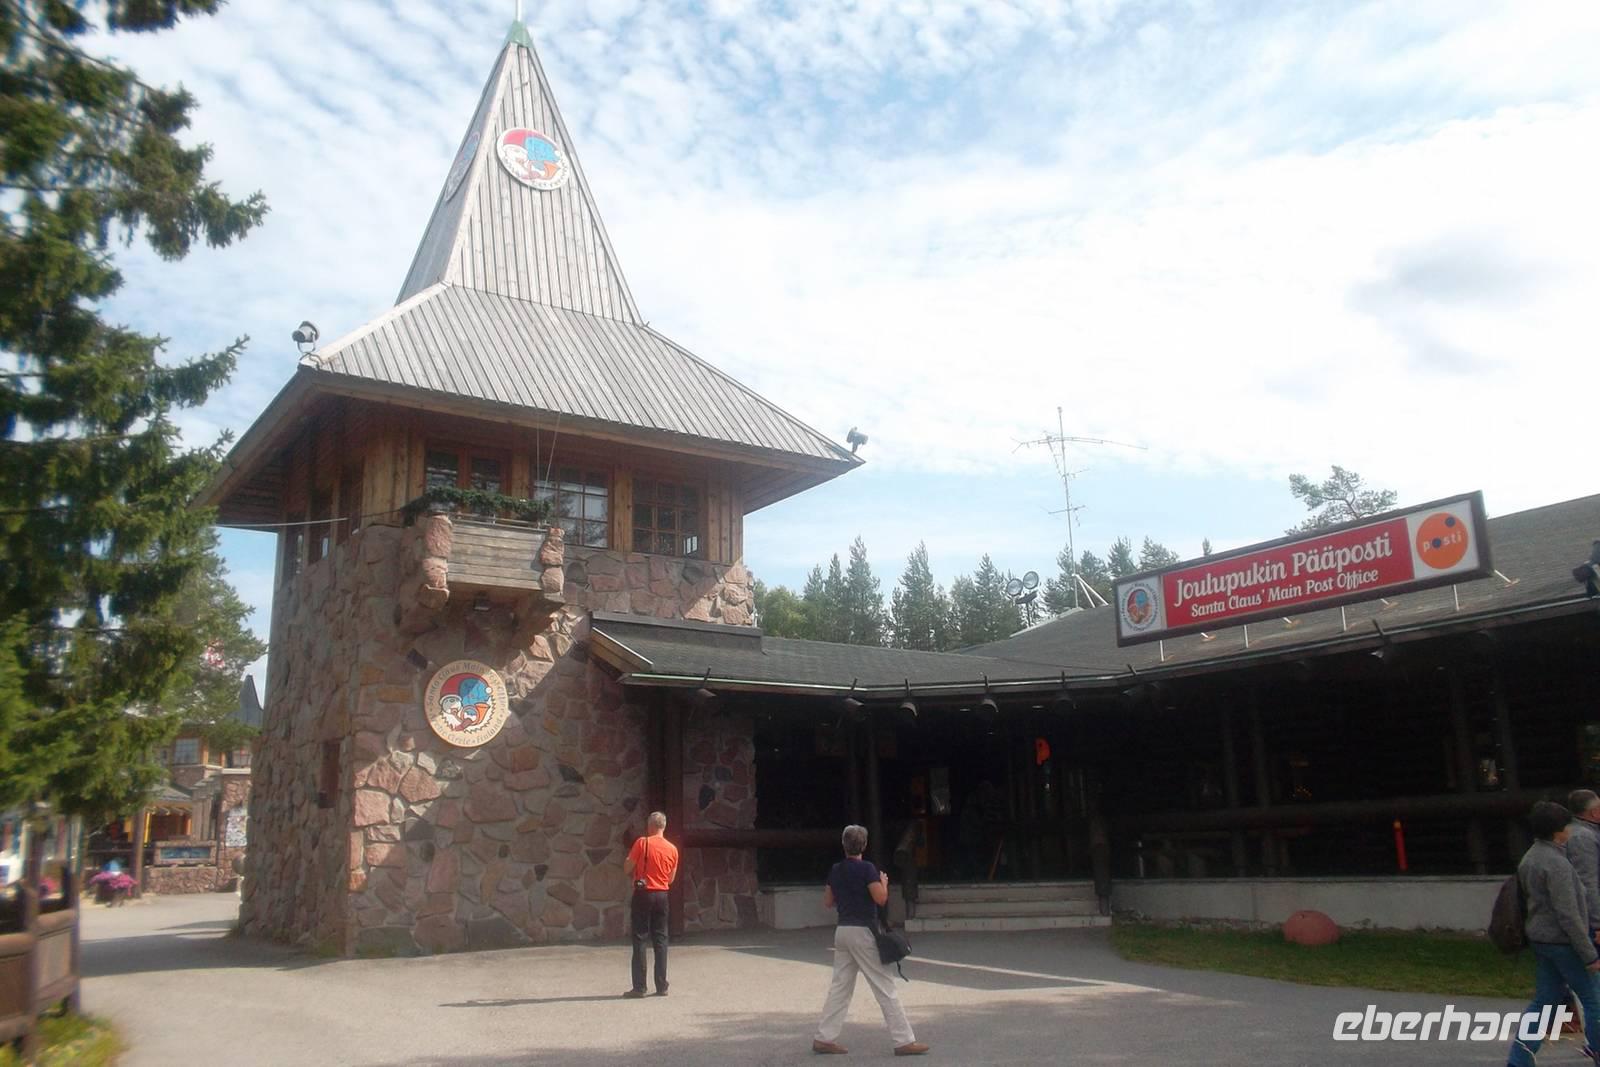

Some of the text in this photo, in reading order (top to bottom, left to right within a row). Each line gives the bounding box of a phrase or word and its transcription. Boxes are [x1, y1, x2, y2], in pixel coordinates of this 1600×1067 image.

[1174, 559, 1287, 607] Joulupukin
[1292, 532, 1392, 576] Pääposti
[1191, 602, 1226, 617] Santa
[1268, 584, 1302, 602] Main
[1306, 577, 1334, 594] Post
[1336, 569, 1379, 590] Office
